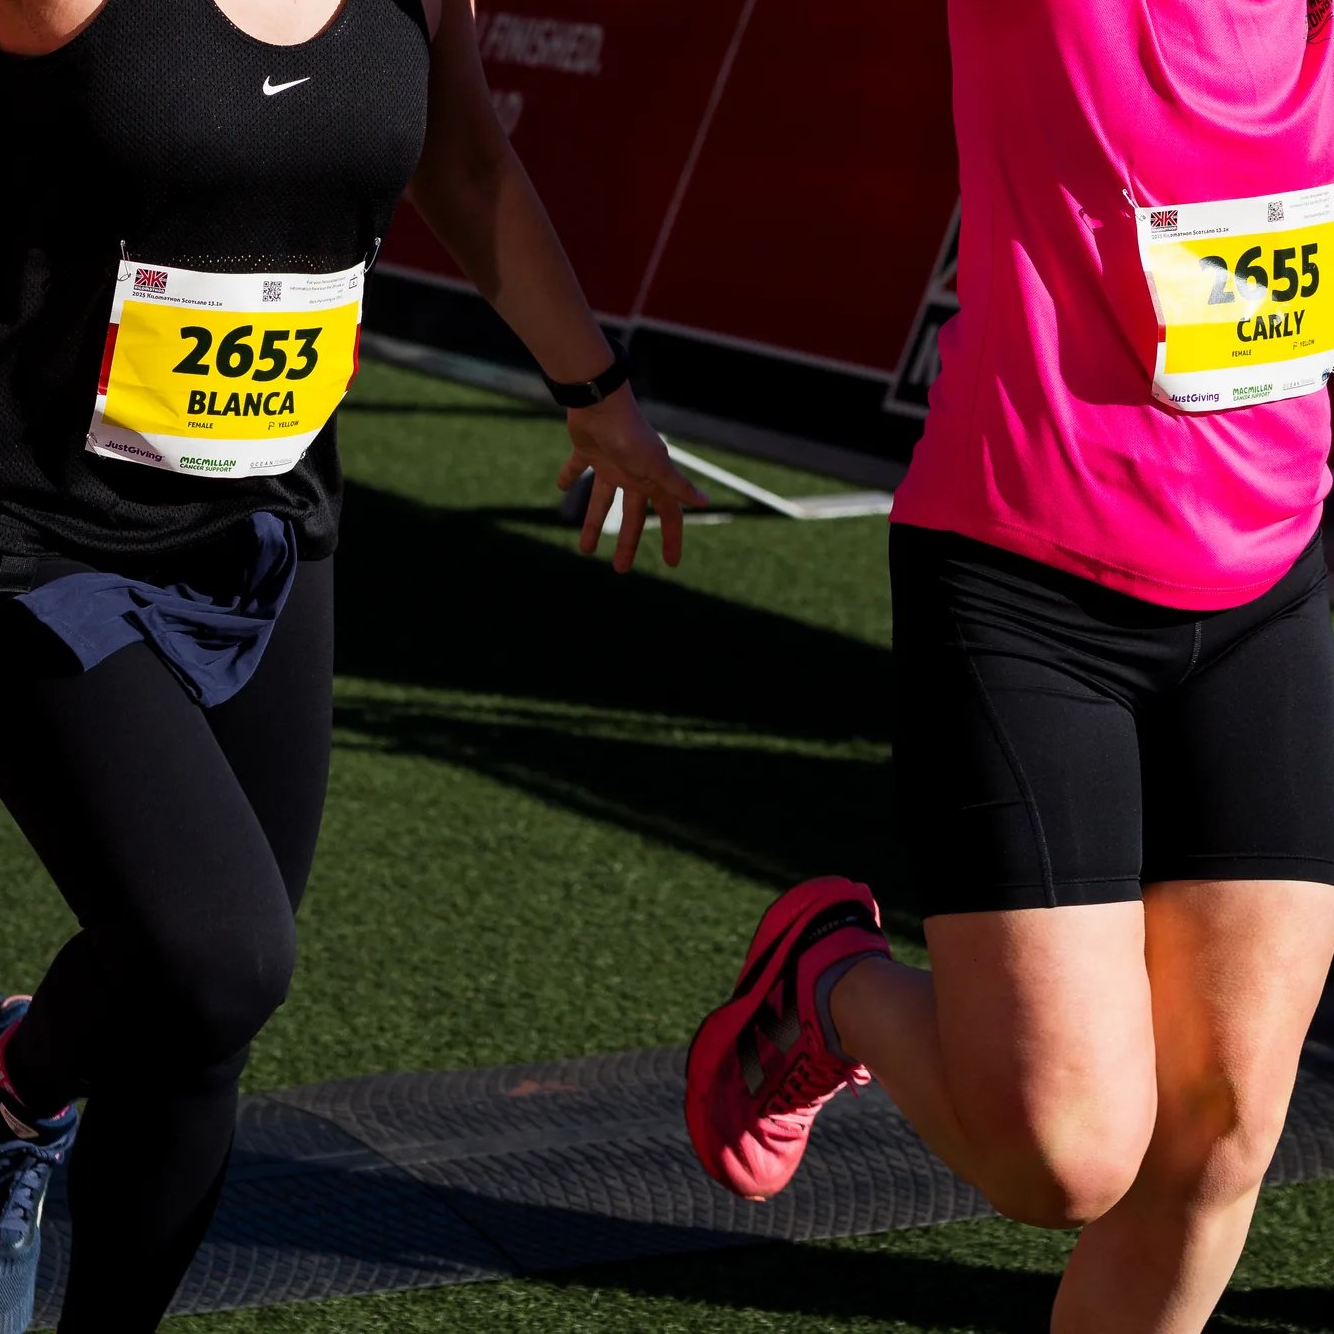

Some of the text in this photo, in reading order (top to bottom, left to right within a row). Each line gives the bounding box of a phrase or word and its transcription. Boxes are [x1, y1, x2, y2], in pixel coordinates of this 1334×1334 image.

[1199, 243, 1320, 306] 2655
[1236, 310, 1305, 342] CARLY
[172, 324, 323, 382] 2653
[1232, 349, 1252, 358] FEMALE
[187, 389, 295, 417] BLANCA
[1168, 393, 1220, 403] JustGiving
[1232, 383, 1273, 396] MACMILLAN
[187, 420, 299, 429] FEMALE YELLOW
[105, 440, 164, 463] JustGiving
[180, 456, 237, 467] MACMILLAN
[179, 463, 232, 473] CANCER SUPPORT
